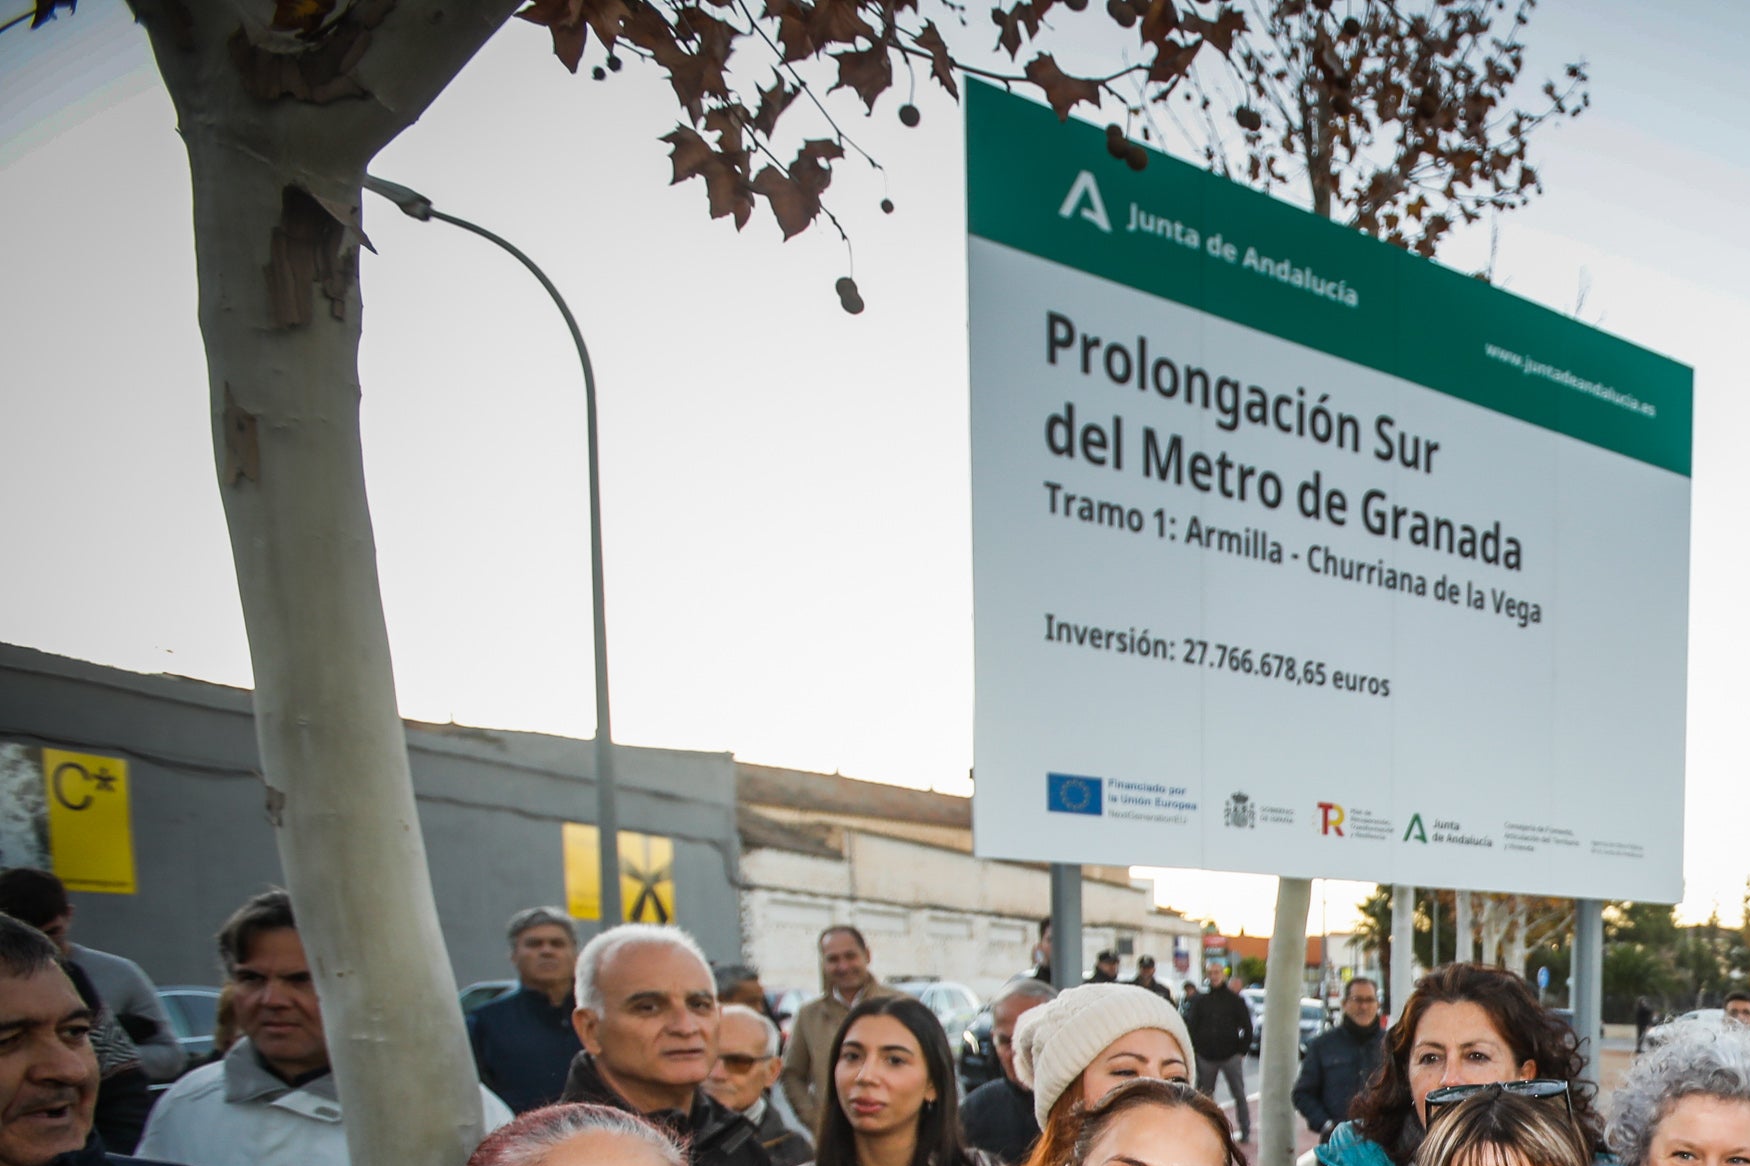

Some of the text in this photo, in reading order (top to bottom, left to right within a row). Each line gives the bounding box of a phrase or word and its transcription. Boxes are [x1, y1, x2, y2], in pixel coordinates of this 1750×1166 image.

[1126, 202, 1359, 307] Junta de Andalucía
[1046, 311, 1440, 473] Prolongación Sur
[1045, 403, 1523, 571] del Metro de Granada
[1043, 481, 1143, 534] Tramo
[1152, 508, 1177, 541] 1:
[1184, 515, 1283, 564] Armilla
[1307, 544, 1427, 597] Churriana
[1433, 574, 1461, 604] de
[1467, 581, 1486, 611] la
[1491, 588, 1542, 628] Vega
[1044, 613, 1391, 698] Inversión: 27.766.678,65 euros
[1432, 832, 1493, 848] de Andalucía
[1433, 818, 1460, 831] Junta
